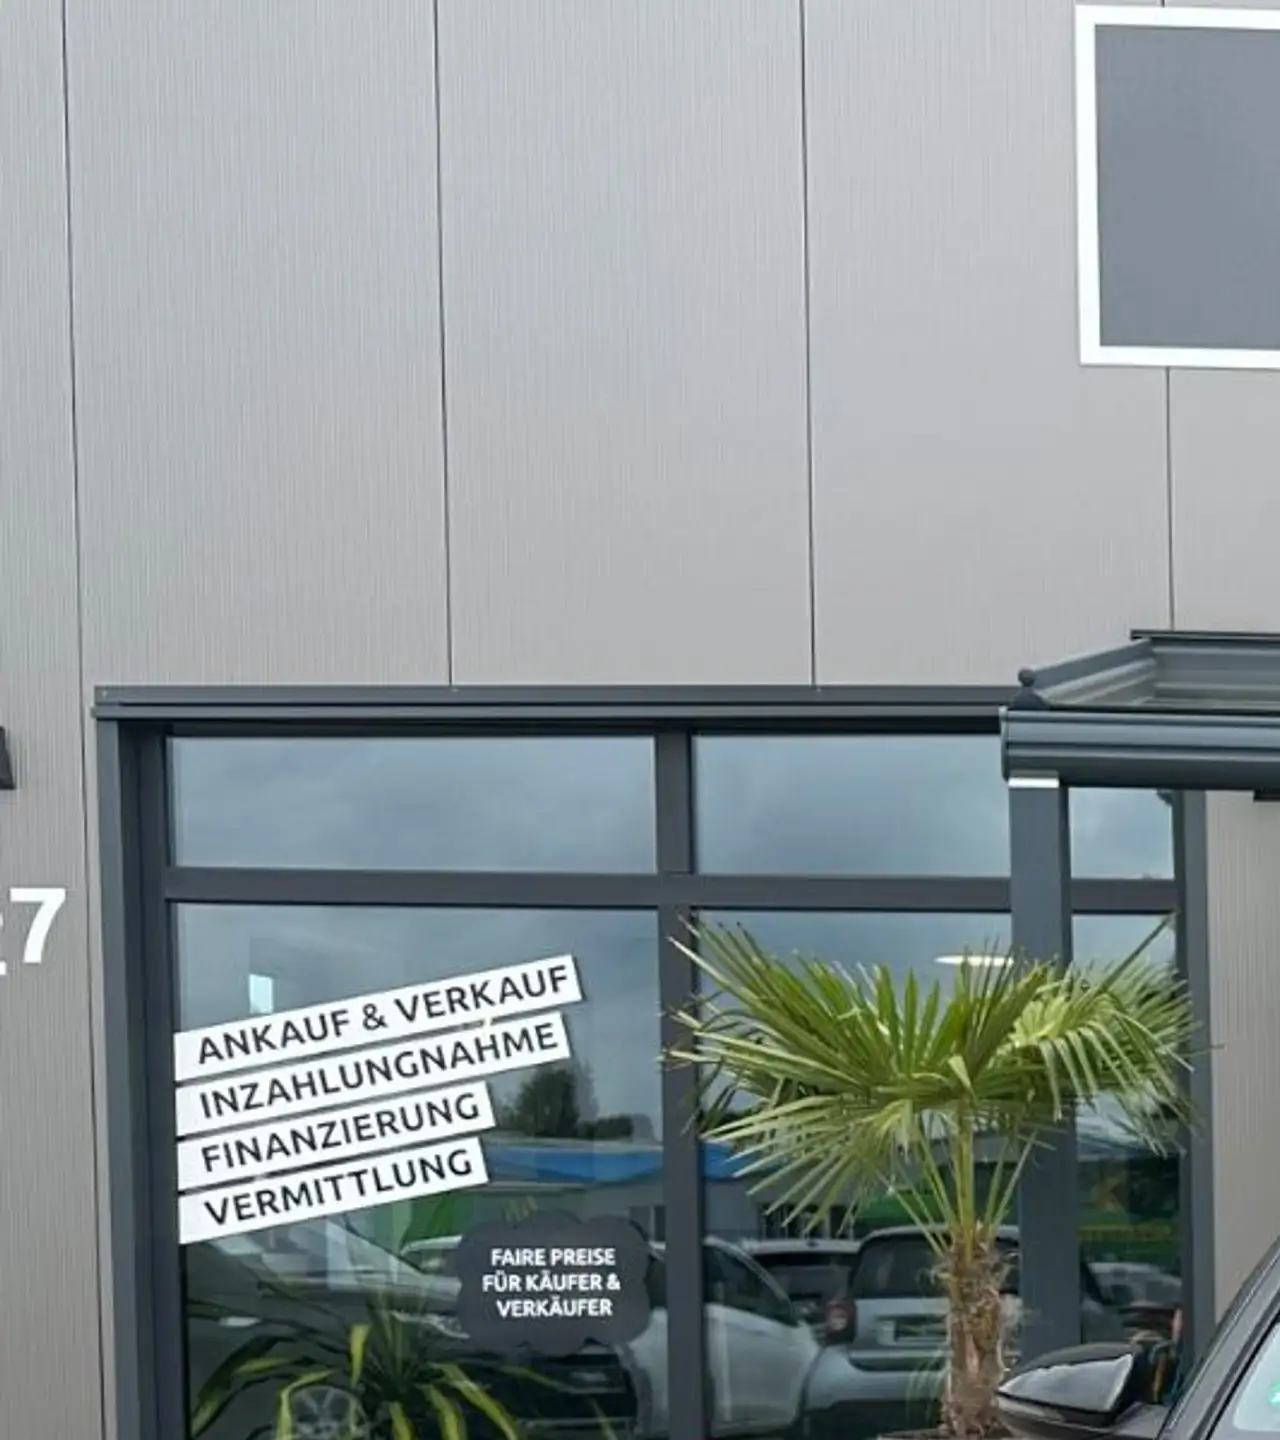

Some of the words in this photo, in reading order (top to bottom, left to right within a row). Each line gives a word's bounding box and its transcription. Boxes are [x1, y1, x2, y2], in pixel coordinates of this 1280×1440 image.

[0, 886, 66, 975] 7
[199, 1009, 350, 1064] ANKAUF
[362, 1003, 388, 1031] &
[394, 965, 568, 1023] VERKAUF
[199, 1023, 558, 1119] INZAHLUNGNAHME
[201, 1093, 480, 1172] FINANZIERUNG
[204, 1149, 473, 1225] VERMITTLUNG
[482, 1270, 522, 1292] FÜR
[525, 1269, 603, 1291] KÄUFER
[606, 1273, 621, 1290] &
[491, 1248, 547, 1266] FAIRE
[551, 1248, 616, 1266] PREISE
[496, 1295, 613, 1317] VERKÄUFER
